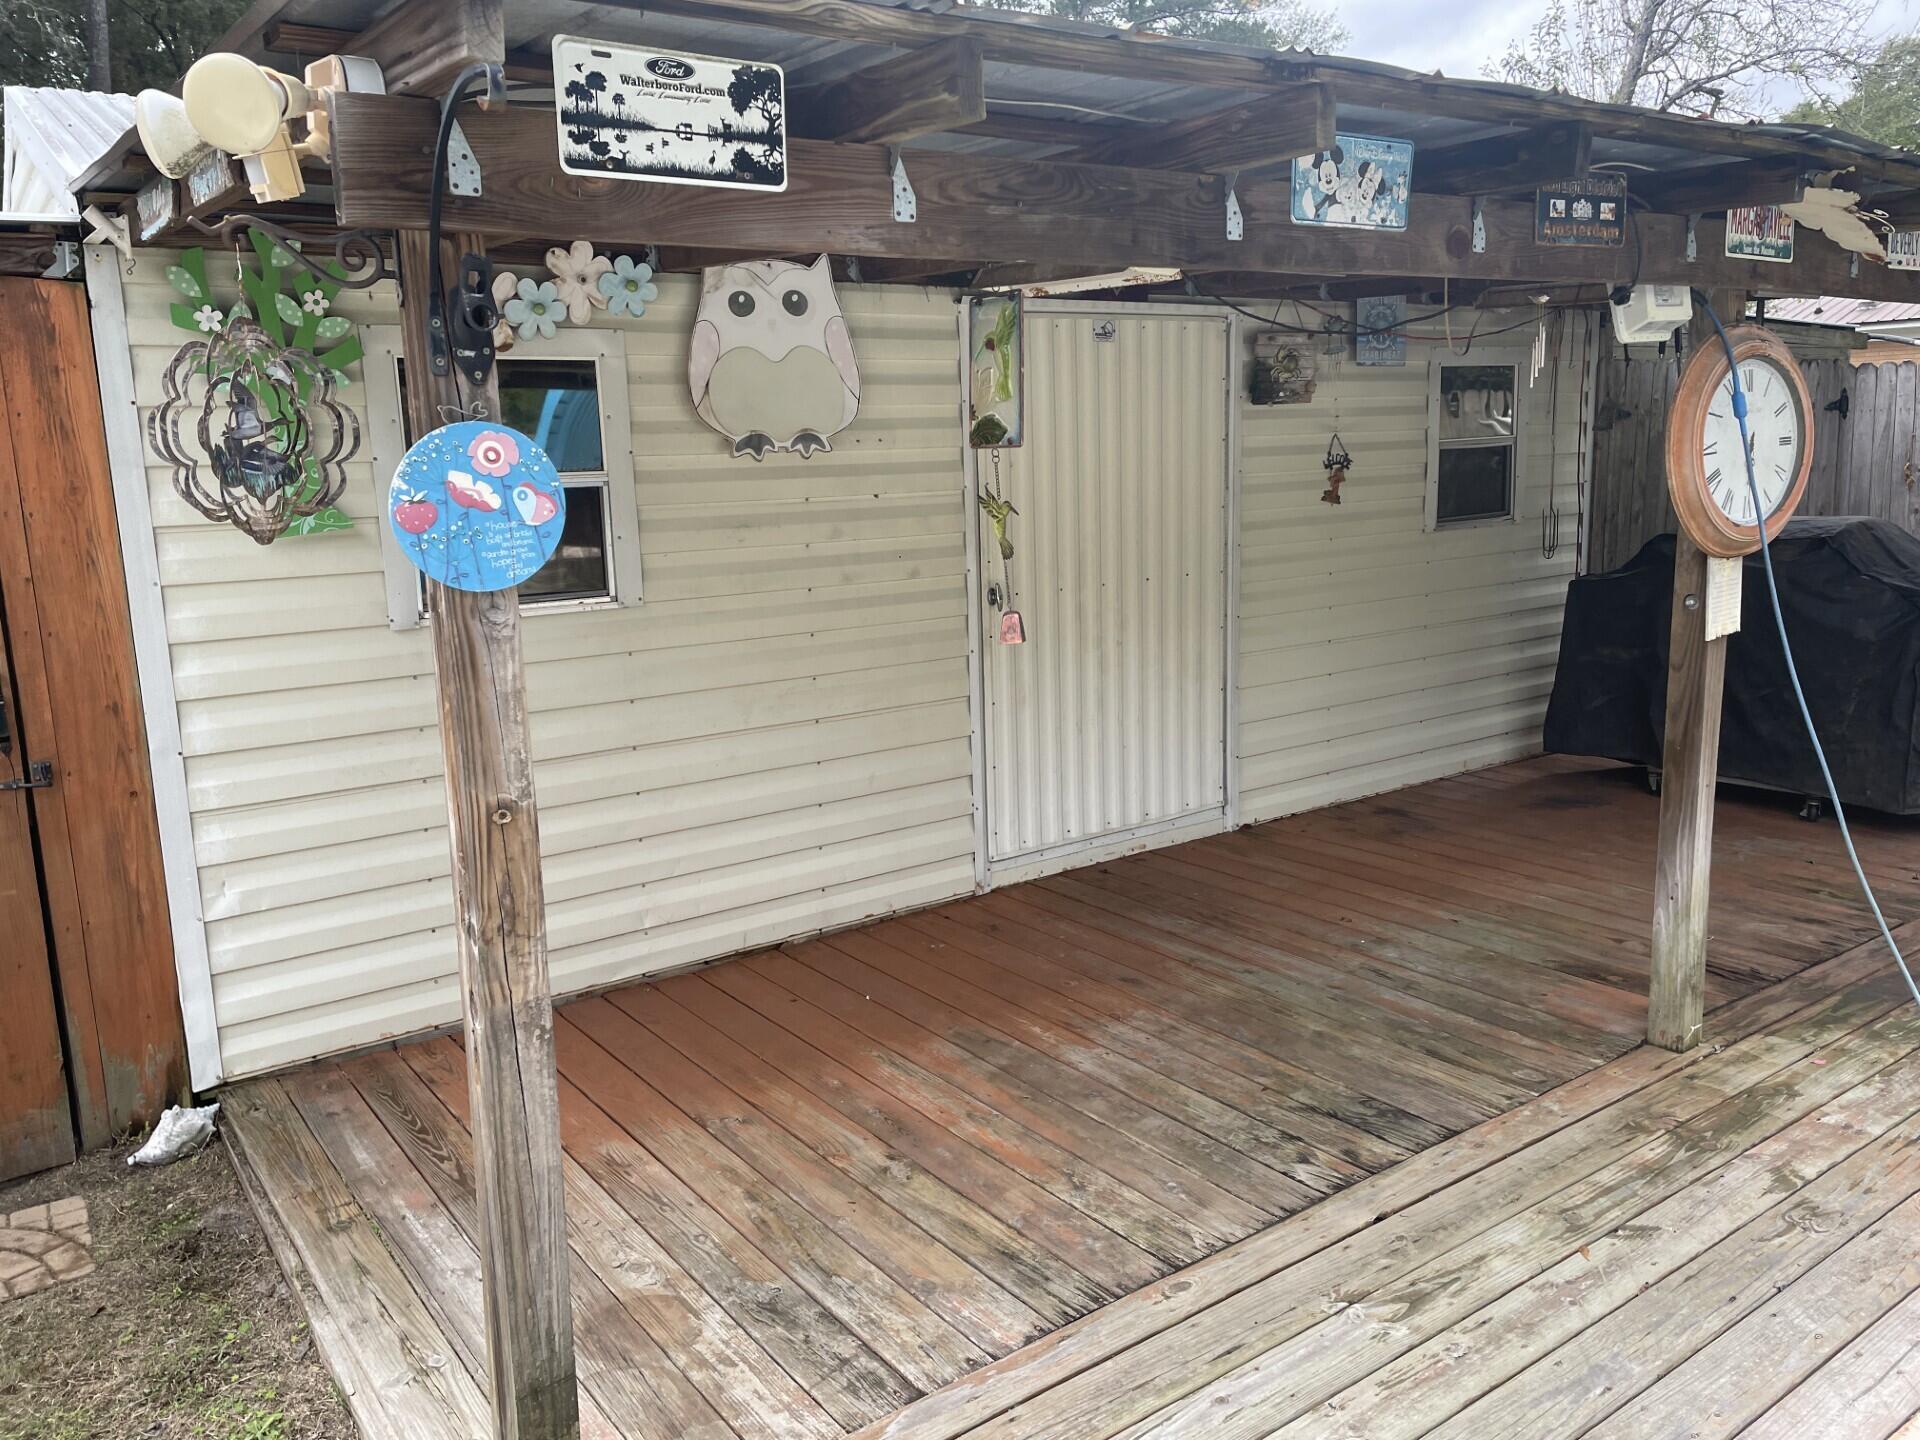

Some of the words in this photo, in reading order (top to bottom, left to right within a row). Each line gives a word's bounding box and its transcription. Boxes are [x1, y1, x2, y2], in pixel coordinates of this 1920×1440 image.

[655, 60, 685, 77] Ford
[619, 74, 726, 97] WalterboroFord.com
[1544, 221, 1619, 238] Amsterdam
